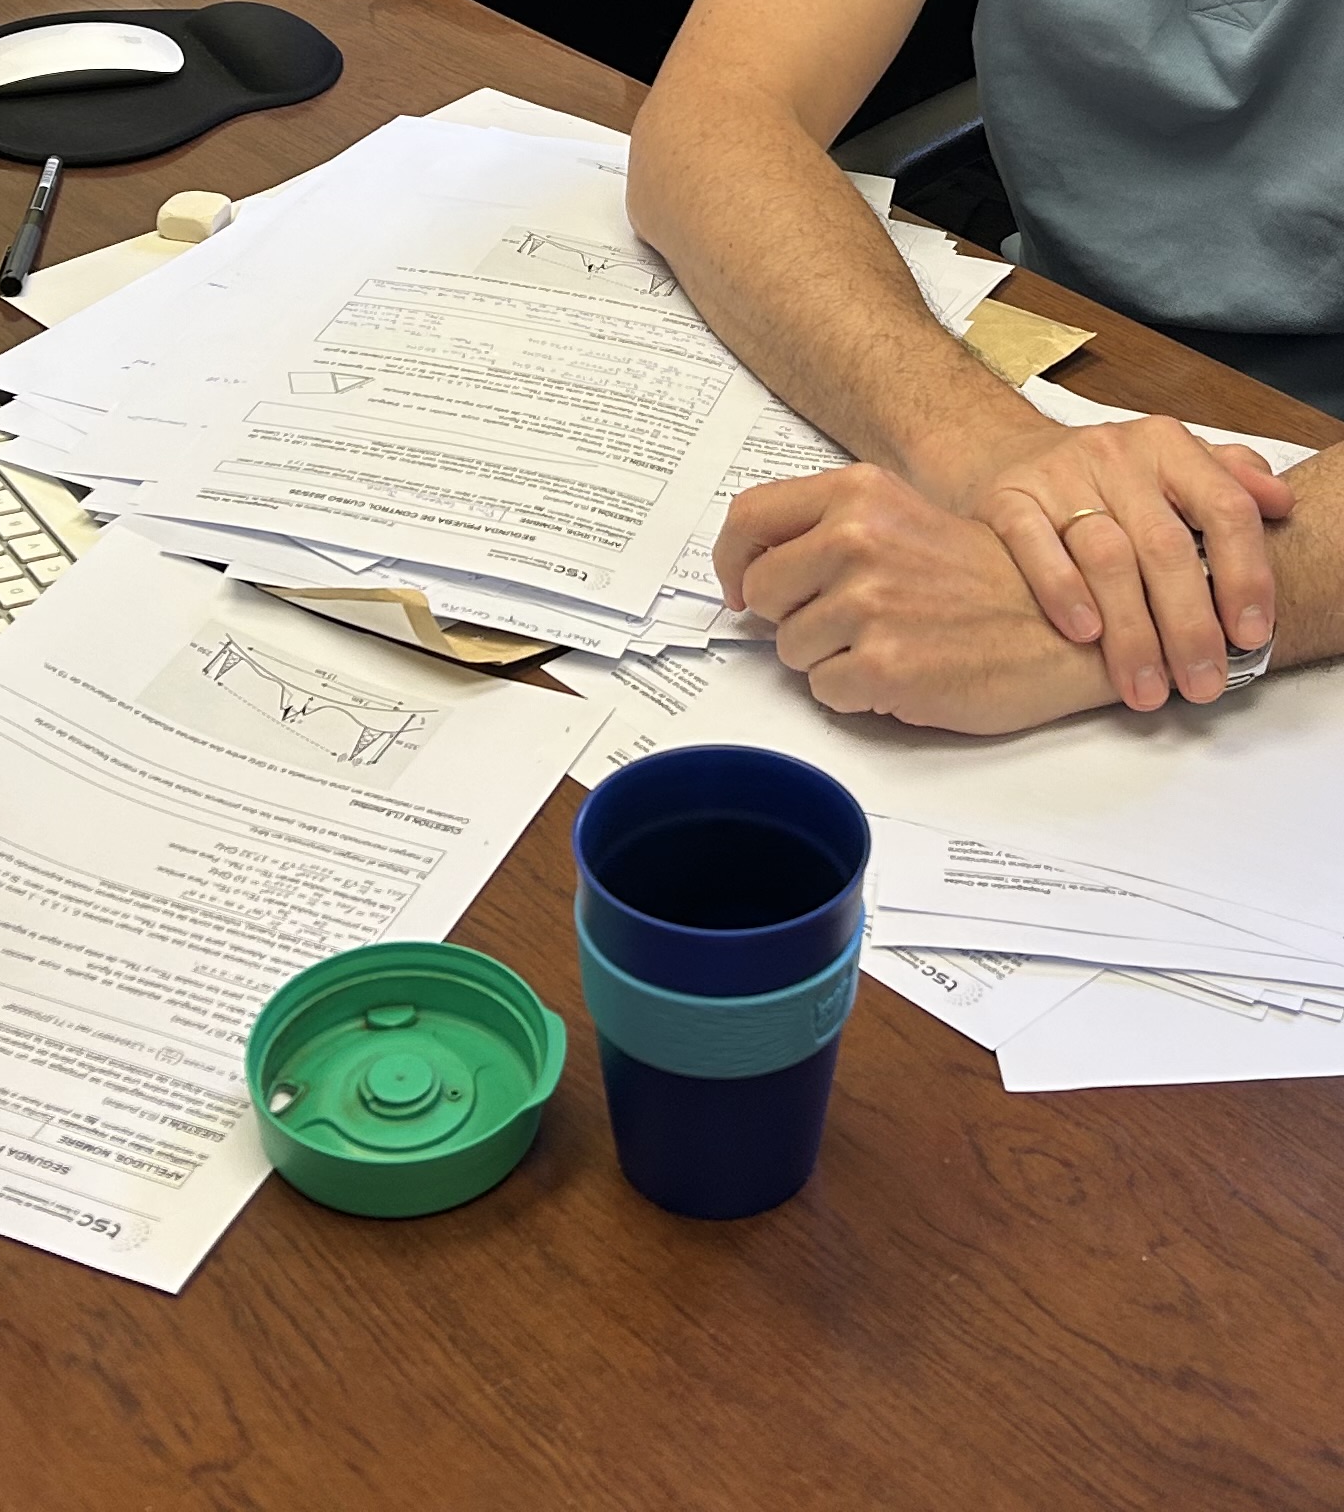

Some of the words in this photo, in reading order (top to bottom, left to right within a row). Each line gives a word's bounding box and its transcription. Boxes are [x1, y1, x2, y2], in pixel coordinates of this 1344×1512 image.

[921, 960, 958, 993] tsc
[6, 1147, 72, 1175] SEGUNDA
[76, 1213, 122, 1240] tsc
